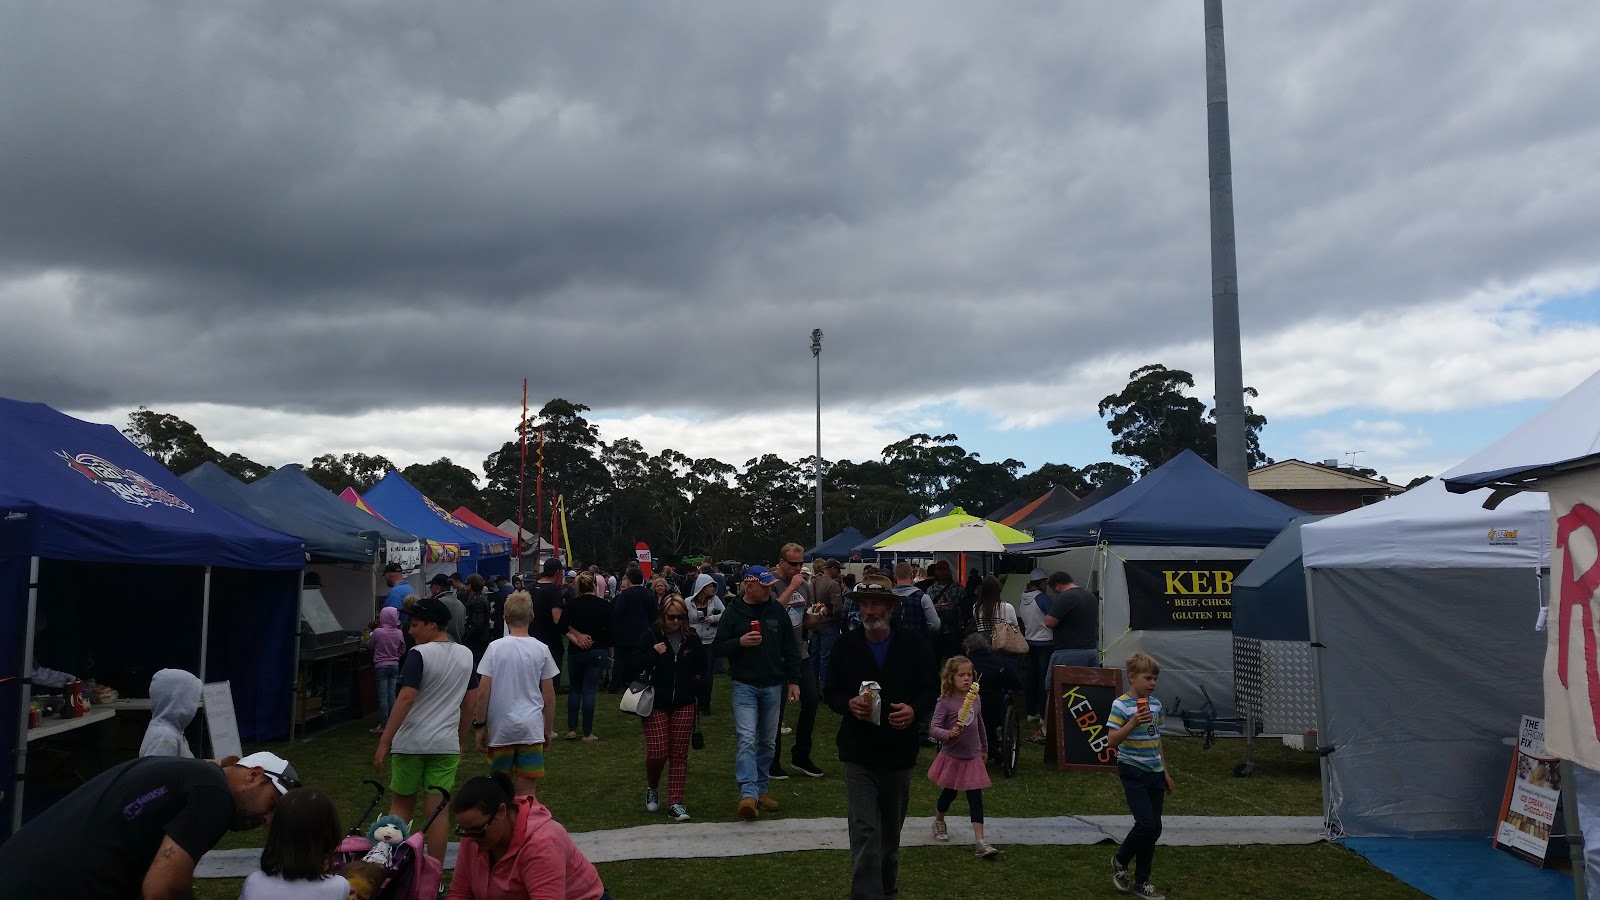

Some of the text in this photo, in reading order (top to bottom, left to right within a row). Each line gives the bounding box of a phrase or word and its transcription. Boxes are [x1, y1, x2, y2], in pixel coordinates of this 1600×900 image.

[1174, 598, 1231, 607] BEEF, CHICK
[1172, 611, 1213, 620] (GLUTEN
[1062, 685, 1118, 763] KEBABS
[1525, 718, 1540, 730] THE
[1520, 737, 1533, 749] FIX
[1520, 794, 1528, 803] ICE
